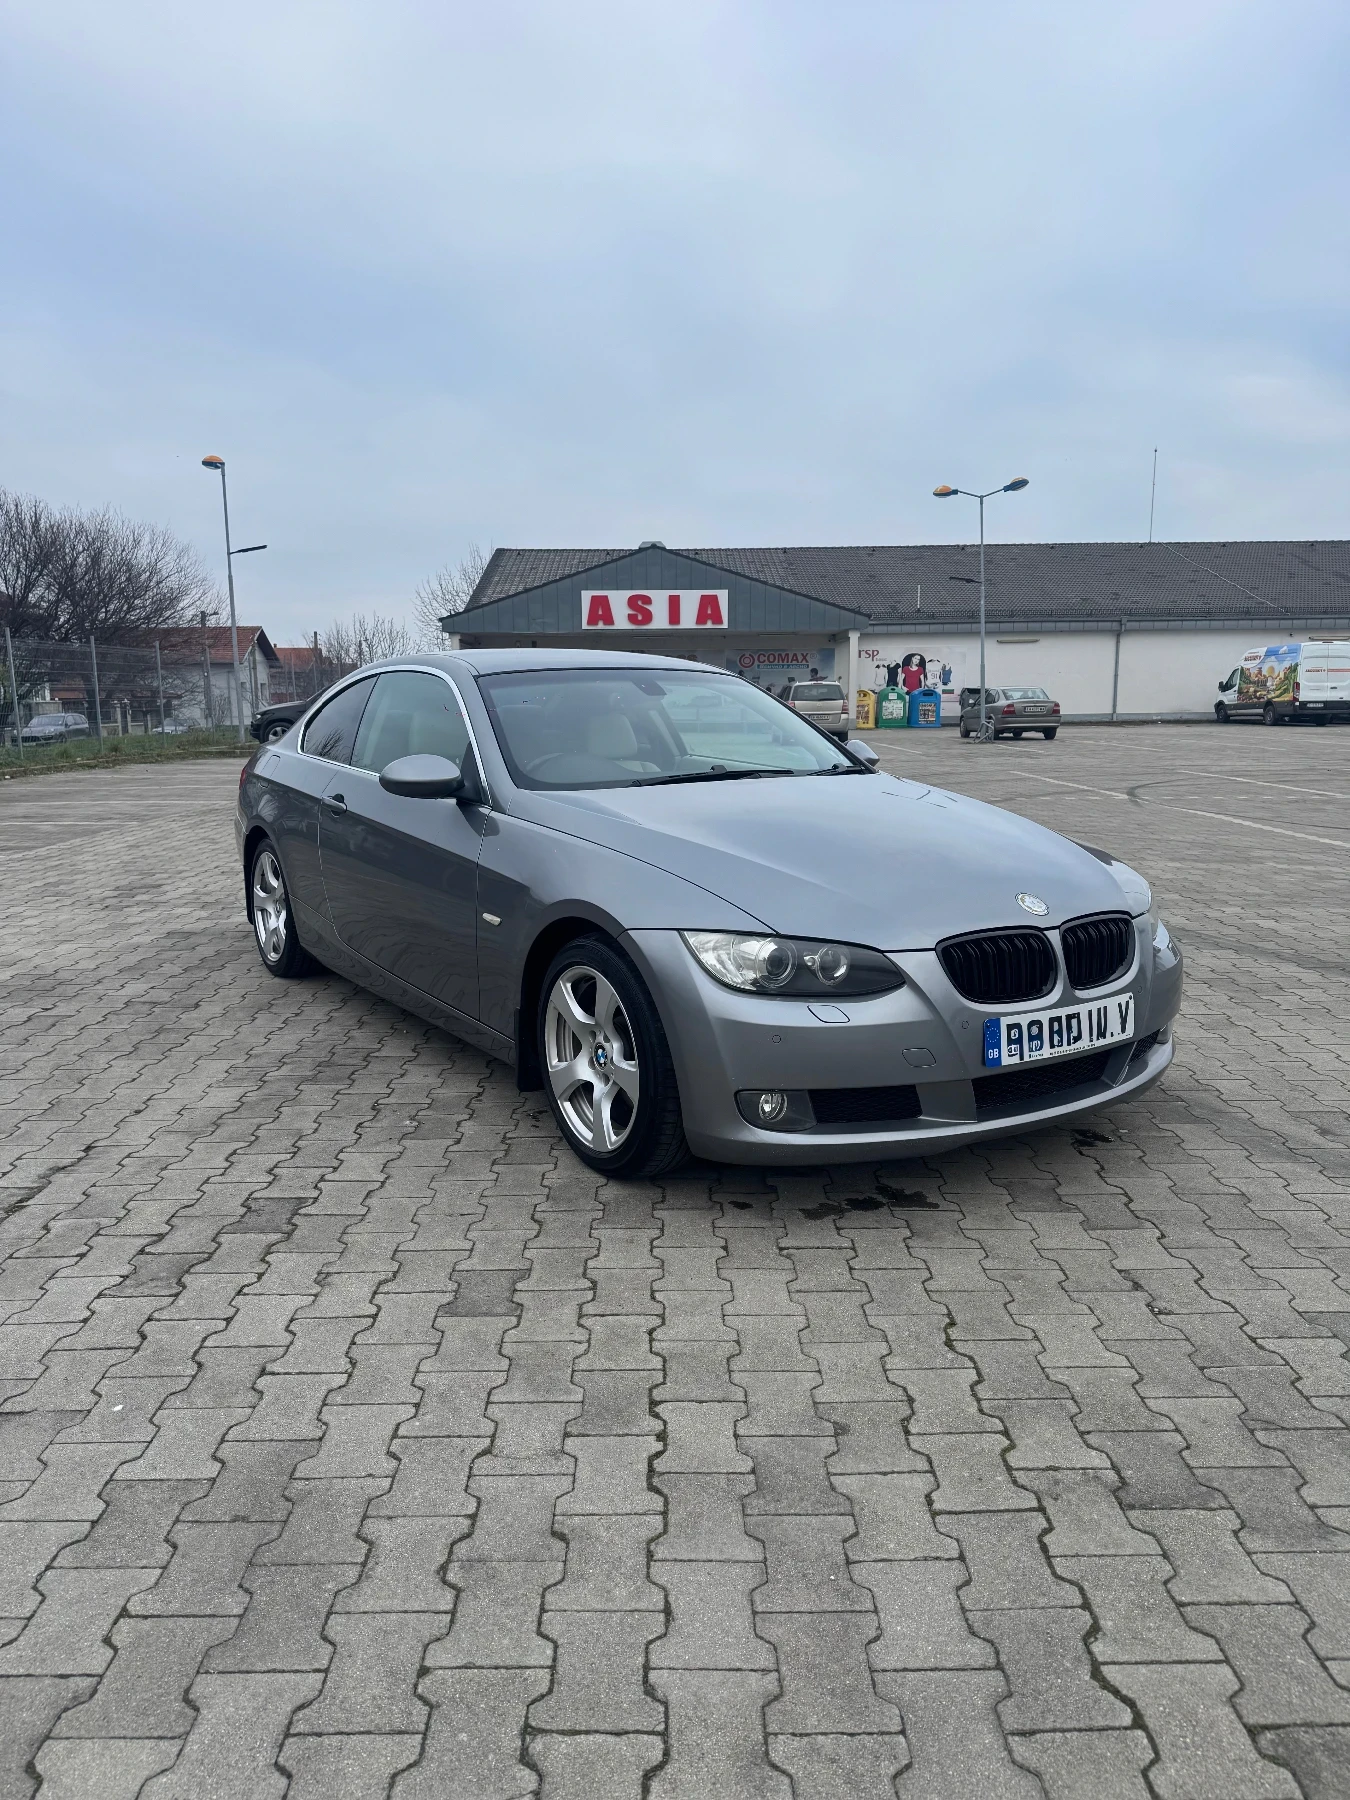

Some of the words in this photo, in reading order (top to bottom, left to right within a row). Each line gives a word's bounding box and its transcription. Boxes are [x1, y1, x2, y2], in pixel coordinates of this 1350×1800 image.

[586, 593, 724, 626] ASIA
[757, 652, 809, 664] COMAX
[988, 1048, 999, 1059] GB
